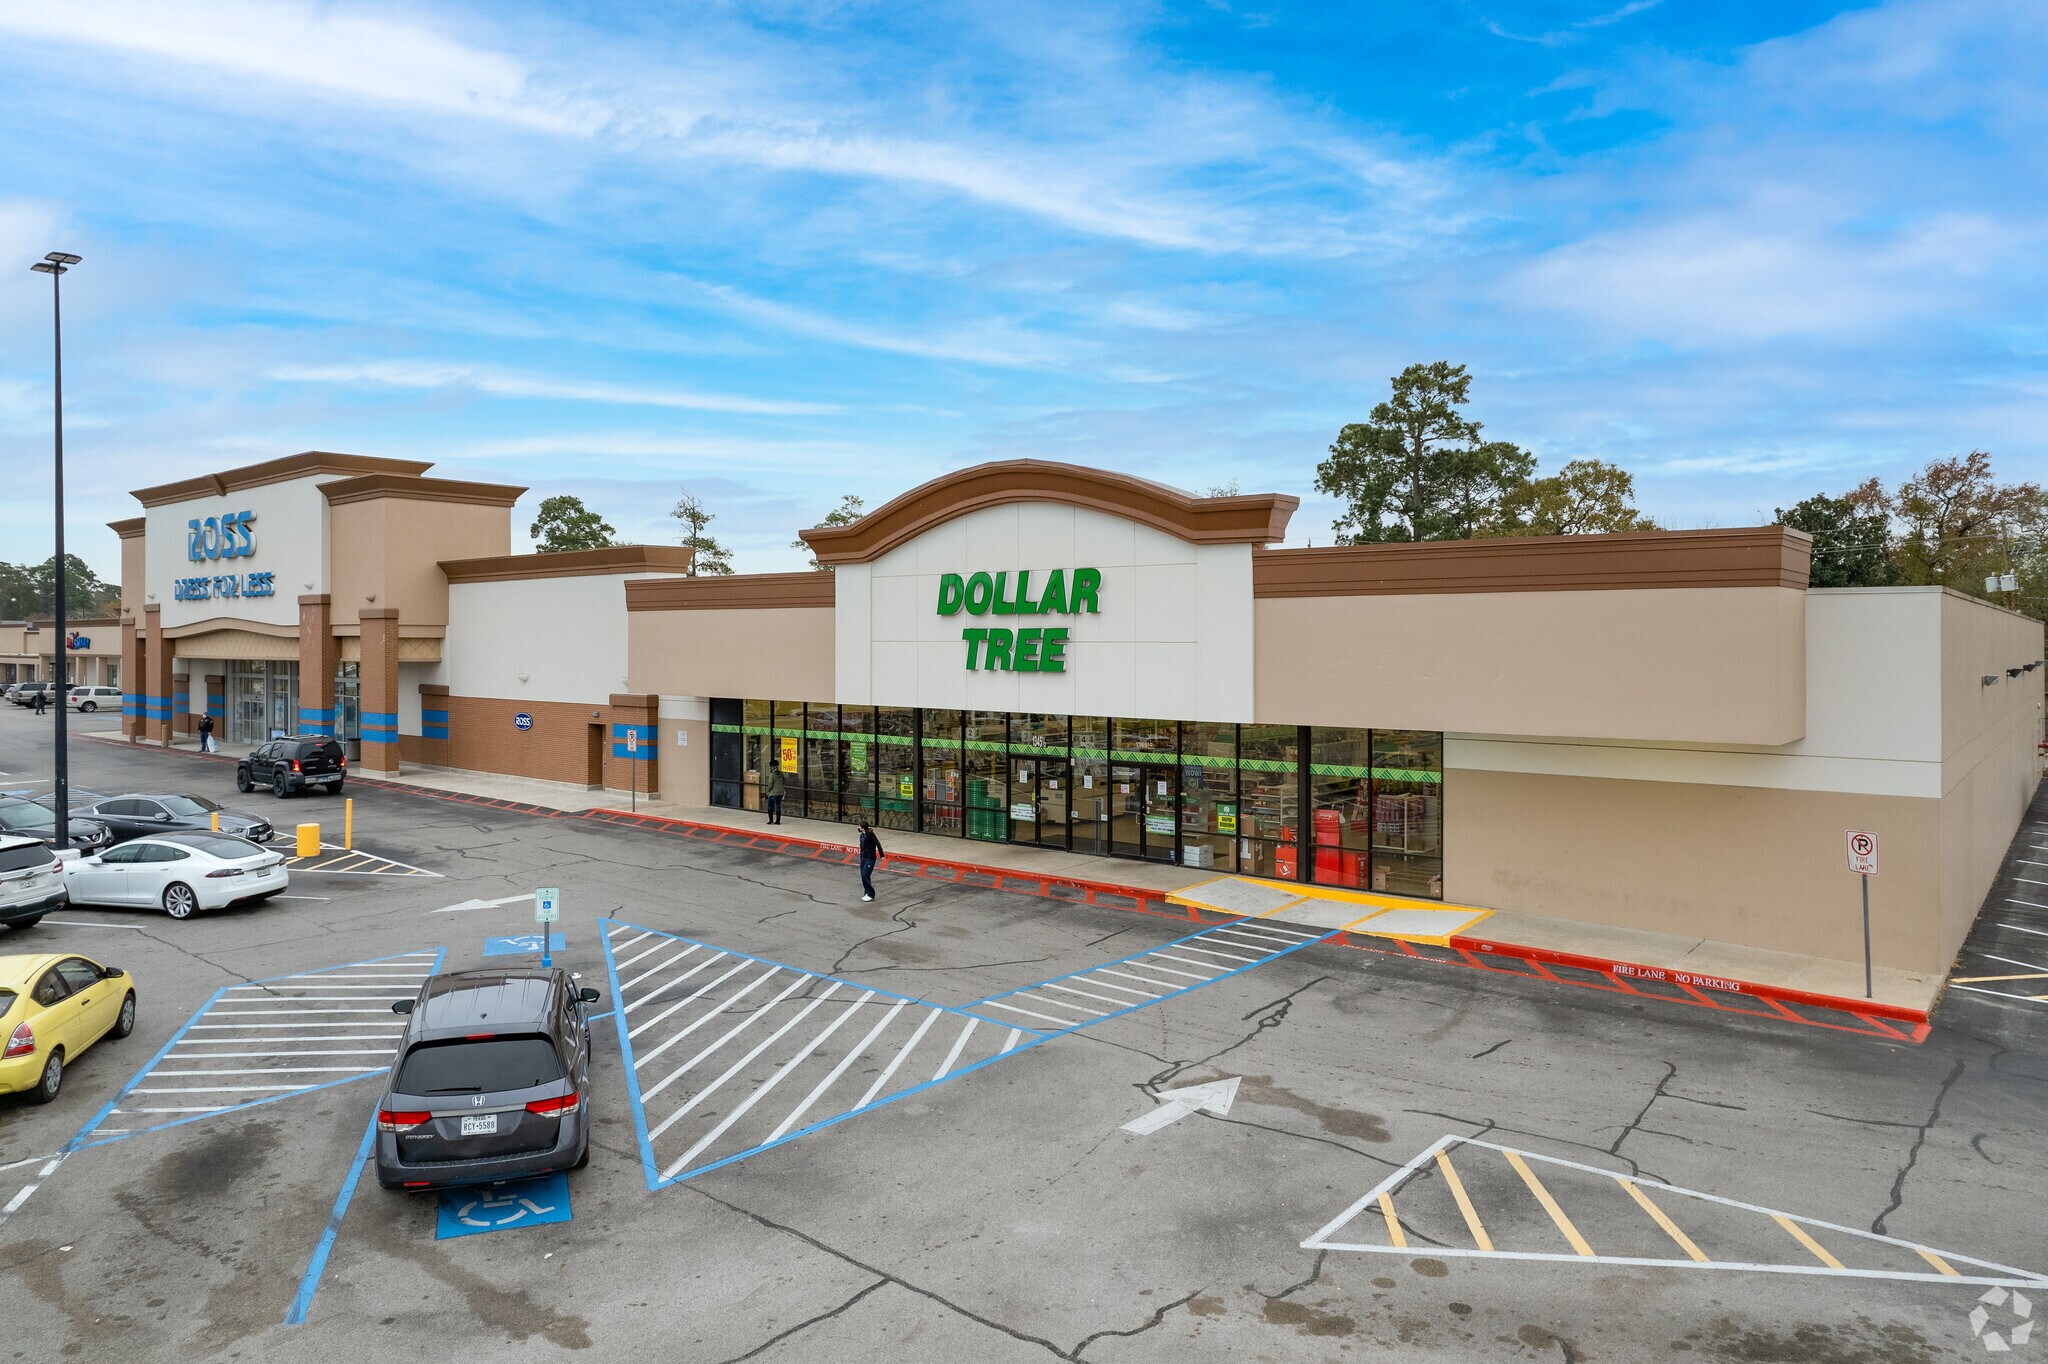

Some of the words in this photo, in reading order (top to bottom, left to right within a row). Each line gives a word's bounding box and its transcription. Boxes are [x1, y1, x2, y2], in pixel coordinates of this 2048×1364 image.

[187, 510, 257, 562] ROSS
[174, 577, 212, 601] DRESS
[213, 574, 240, 599] FOR
[241, 571, 276, 597] LESS
[937, 567, 1103, 616] DOLLAR
[962, 627, 1070, 673] TREE
[515, 717, 531, 726] ROSS
[1184, 768, 1202, 777] WOW!
[1856, 856, 1869, 864] FIRE
[1612, 964, 1635, 976] FIRE
[1637, 968, 1666, 980] LANE
[1674, 973, 1691, 983] NO
[1692, 976, 1740, 991] PARKING
